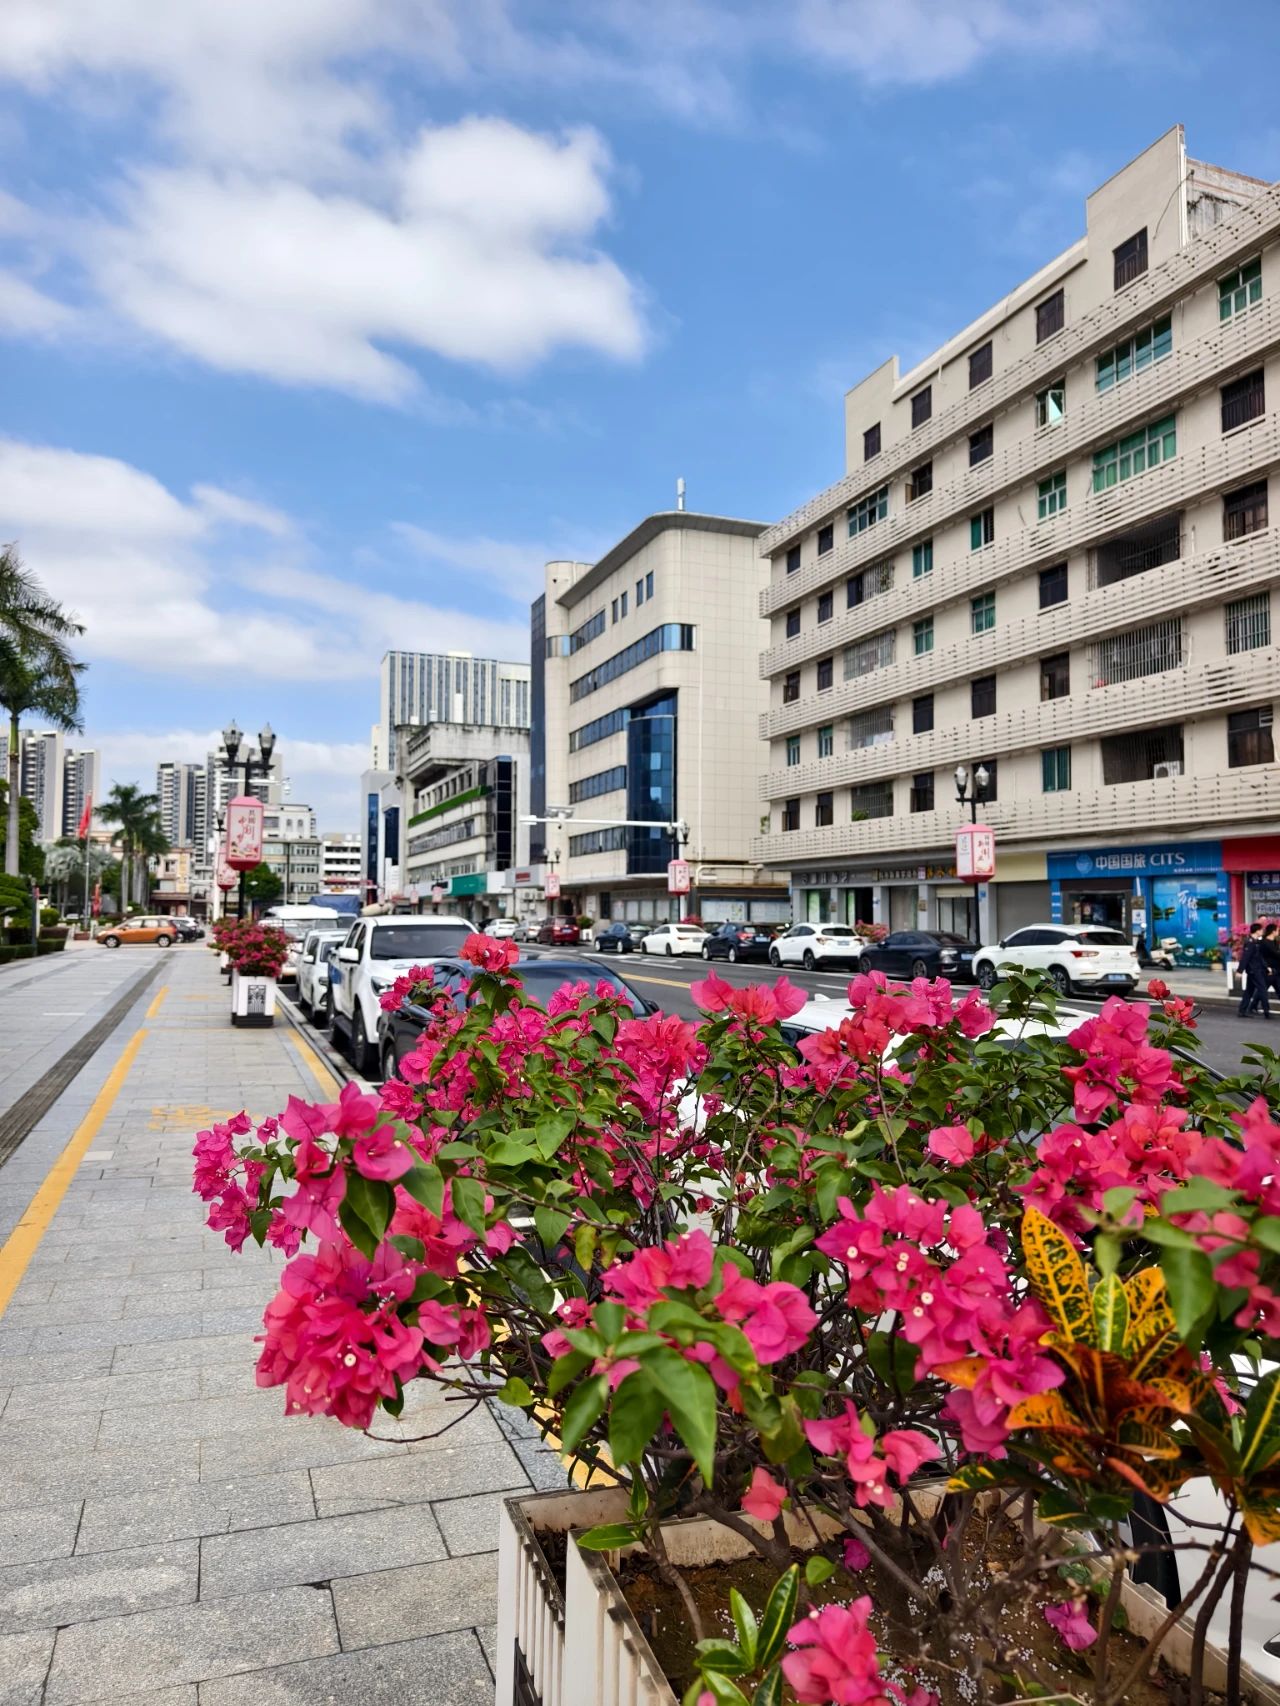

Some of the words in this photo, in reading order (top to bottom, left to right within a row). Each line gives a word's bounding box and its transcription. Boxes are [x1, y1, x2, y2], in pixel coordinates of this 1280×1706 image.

[1095, 853, 1146, 870] 中国国旅
[1150, 852, 1186, 866] CITS
